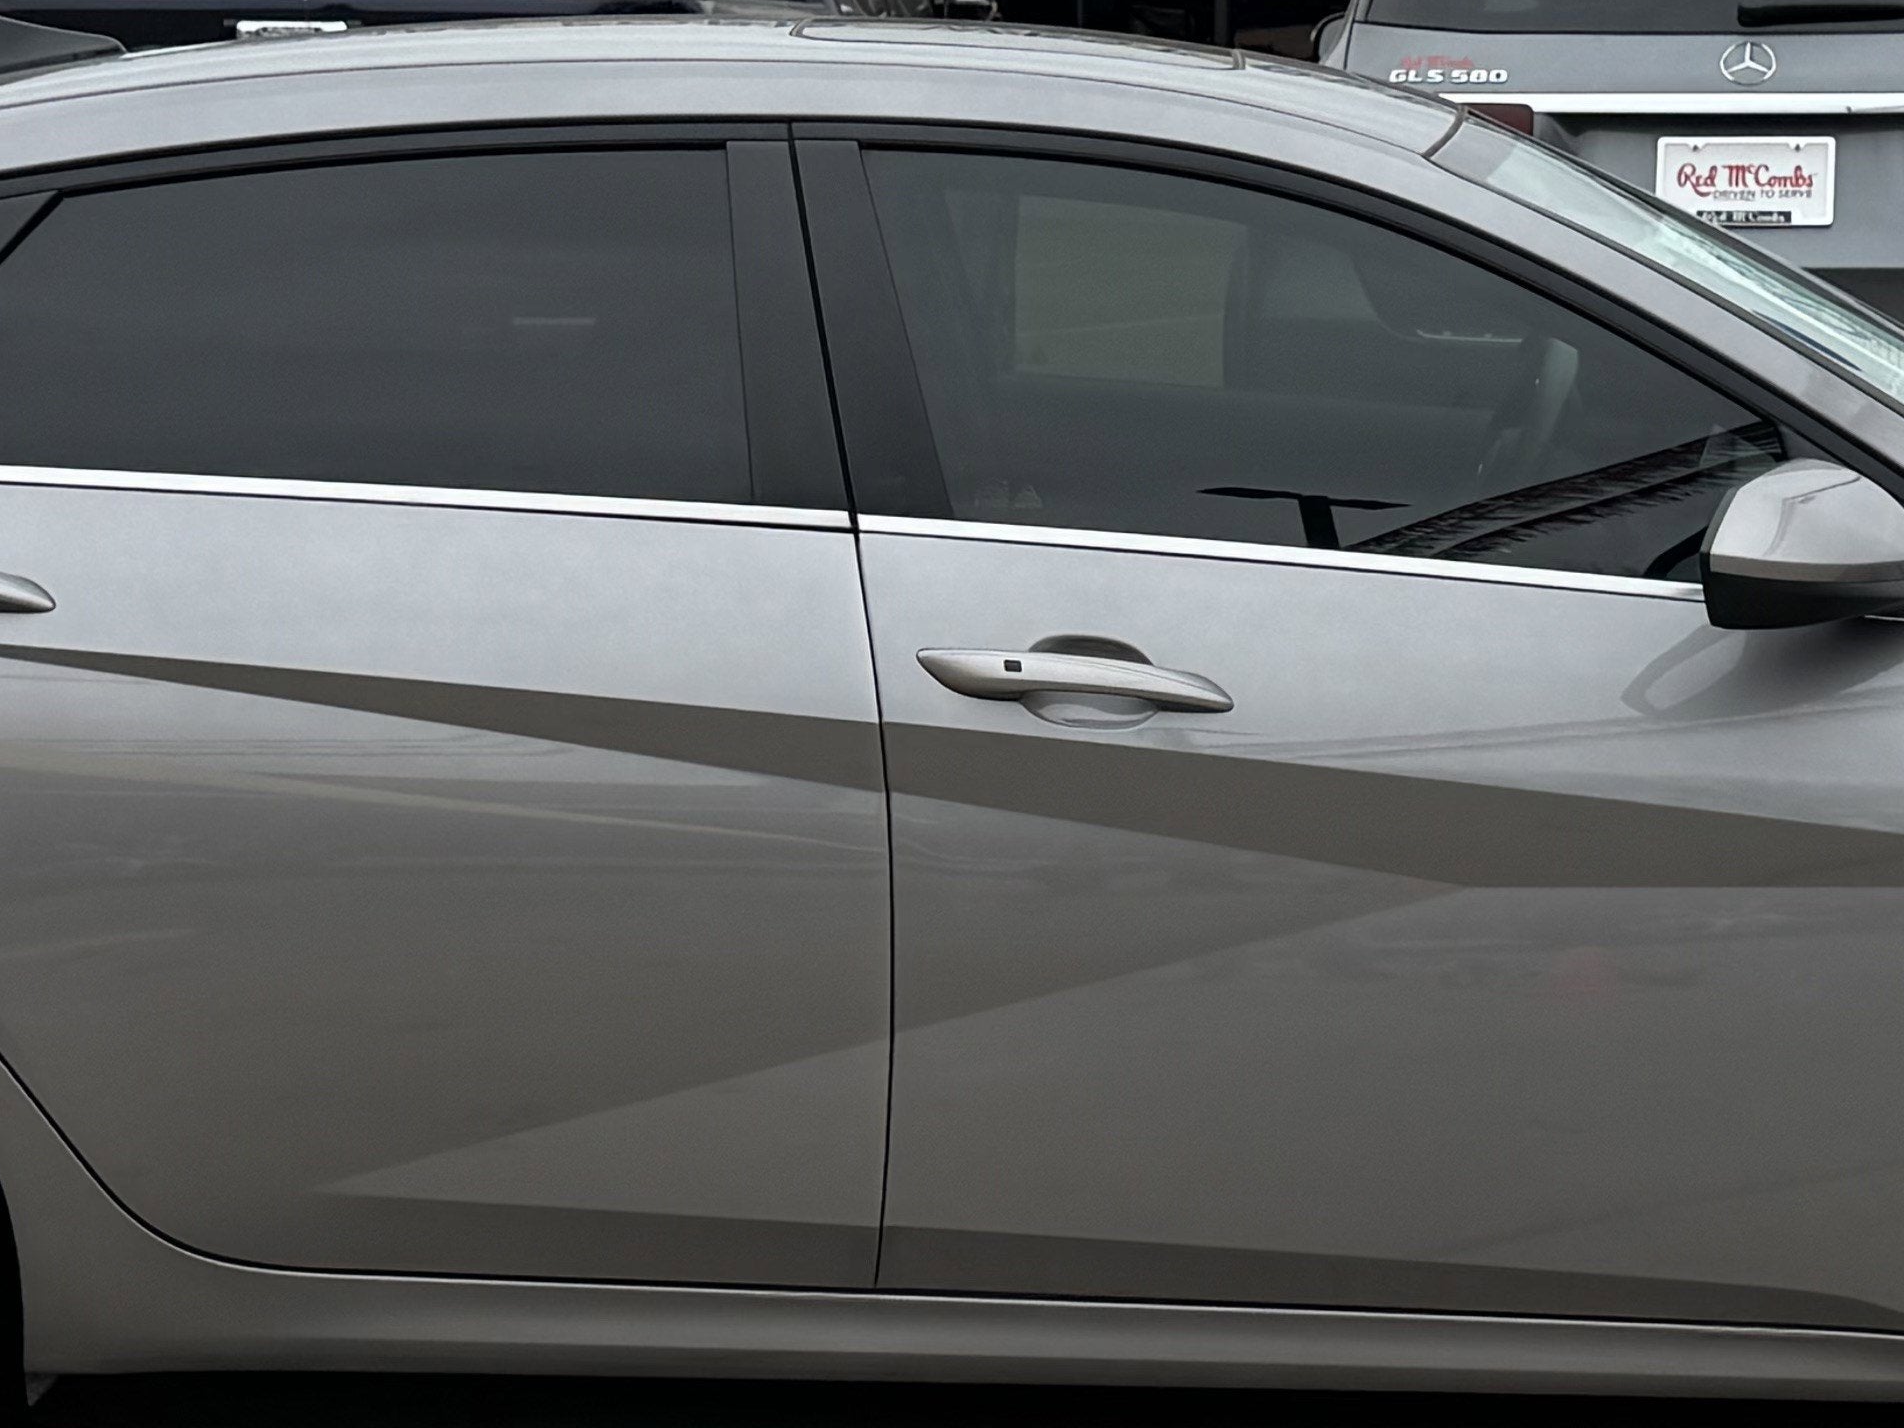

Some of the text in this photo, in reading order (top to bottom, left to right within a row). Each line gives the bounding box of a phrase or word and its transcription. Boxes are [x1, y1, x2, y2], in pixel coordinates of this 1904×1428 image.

[1389, 69, 1444, 83] GLS
[1677, 163, 1718, 197] Red
[1760, 188, 1776, 199] TO
[1778, 187, 1813, 199] SERVE
